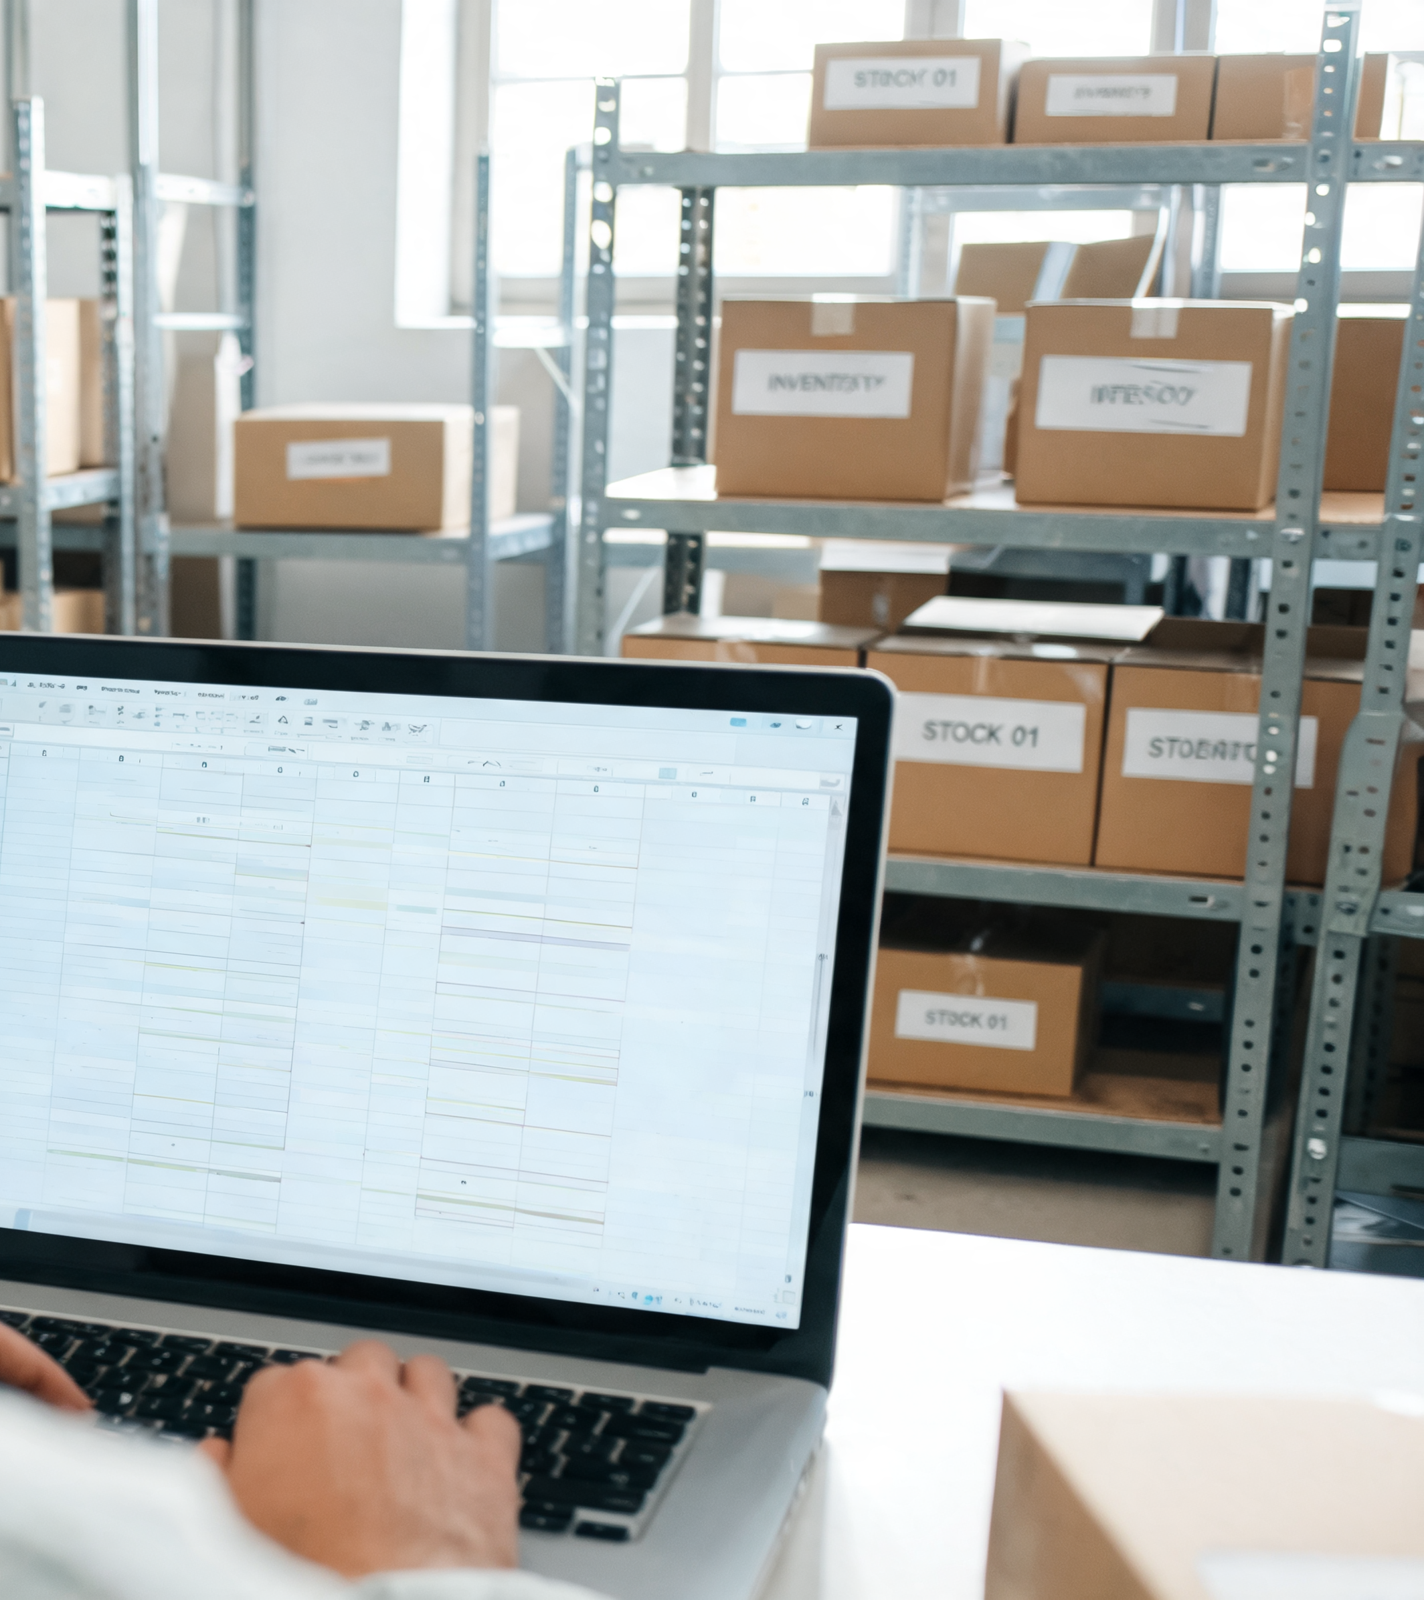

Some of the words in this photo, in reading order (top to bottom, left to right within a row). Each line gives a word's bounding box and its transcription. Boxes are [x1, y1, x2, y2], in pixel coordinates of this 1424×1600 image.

[932, 67, 957, 88] 01
[922, 719, 1003, 744] STOCK
[1011, 724, 1039, 748] 01
[924, 1008, 983, 1029] STOCK
[987, 1013, 1008, 1031] 01
